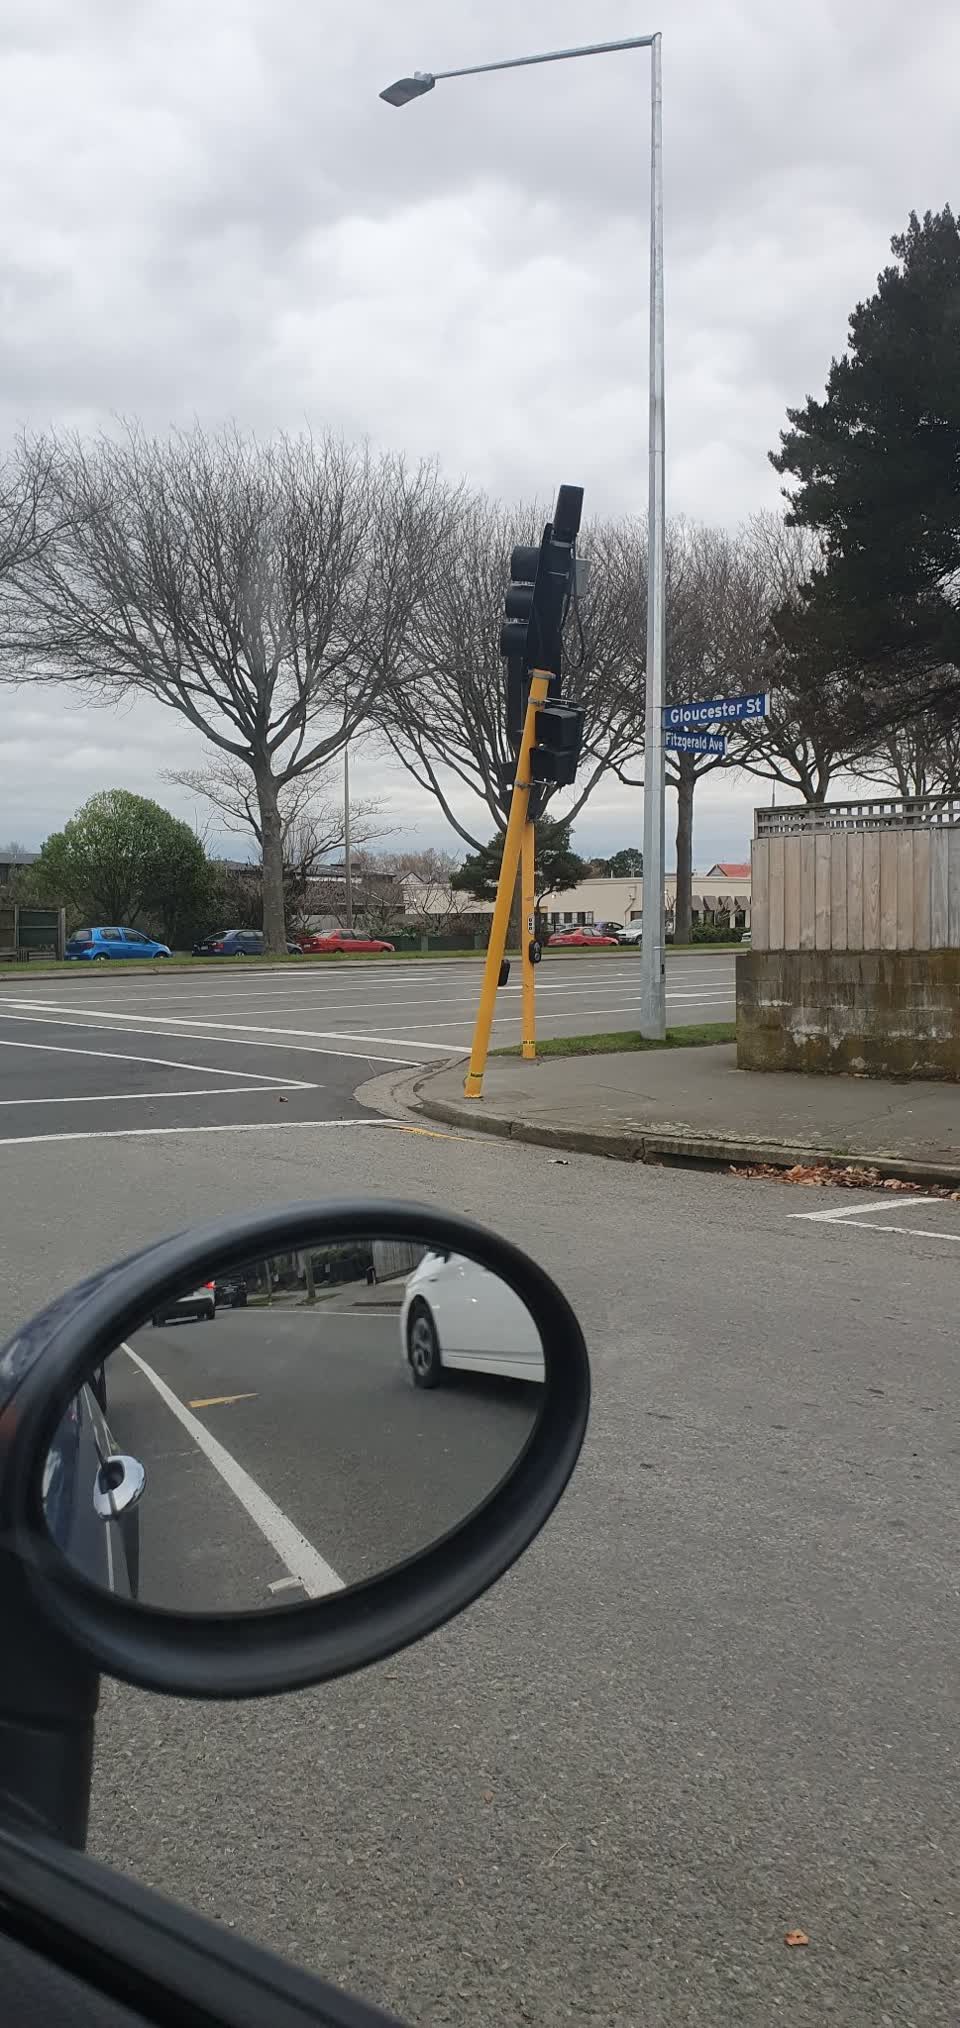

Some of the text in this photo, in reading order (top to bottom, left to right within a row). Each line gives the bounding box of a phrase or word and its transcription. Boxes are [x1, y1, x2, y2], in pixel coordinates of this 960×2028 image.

[670, 698, 762, 723] Gloucester St
[665, 732, 723, 751] Fitzgerald Ave
